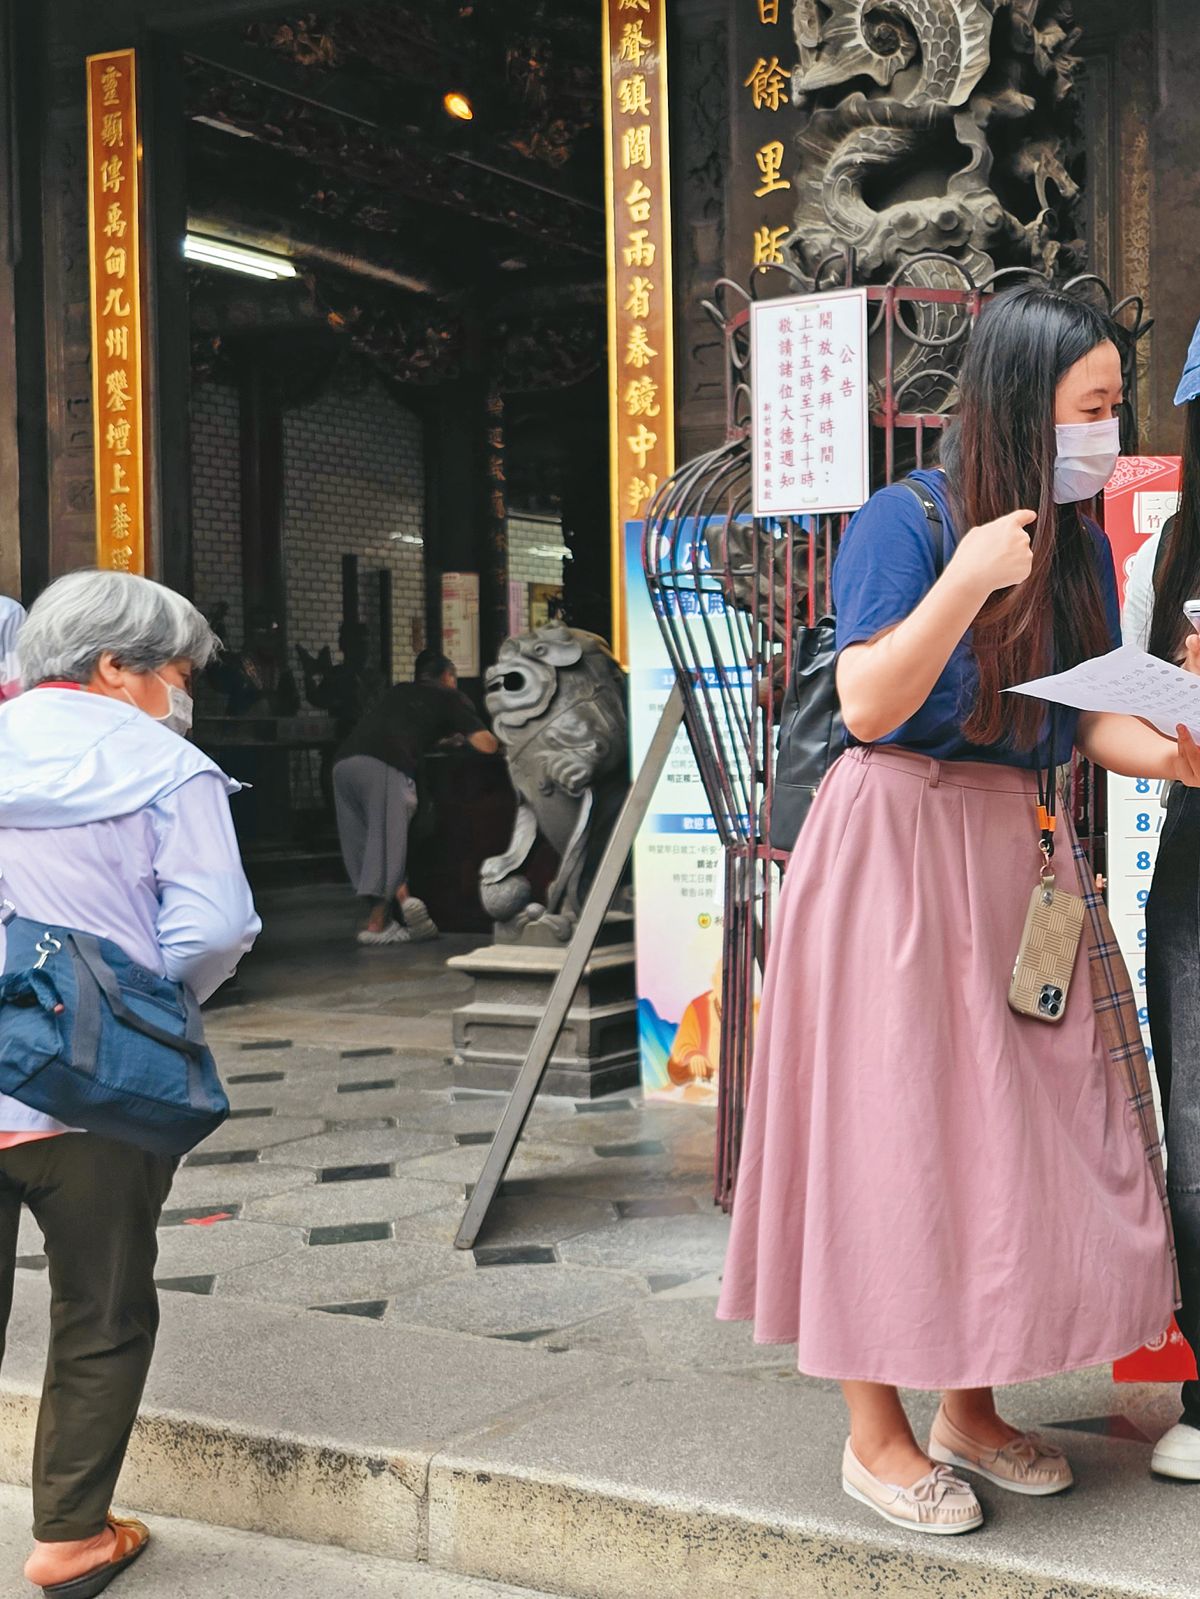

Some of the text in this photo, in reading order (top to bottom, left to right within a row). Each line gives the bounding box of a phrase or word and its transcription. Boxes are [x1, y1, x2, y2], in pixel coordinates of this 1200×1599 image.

[799, 314, 816, 489] 上午五時至下午十時
[839, 344, 856, 397] 公告
